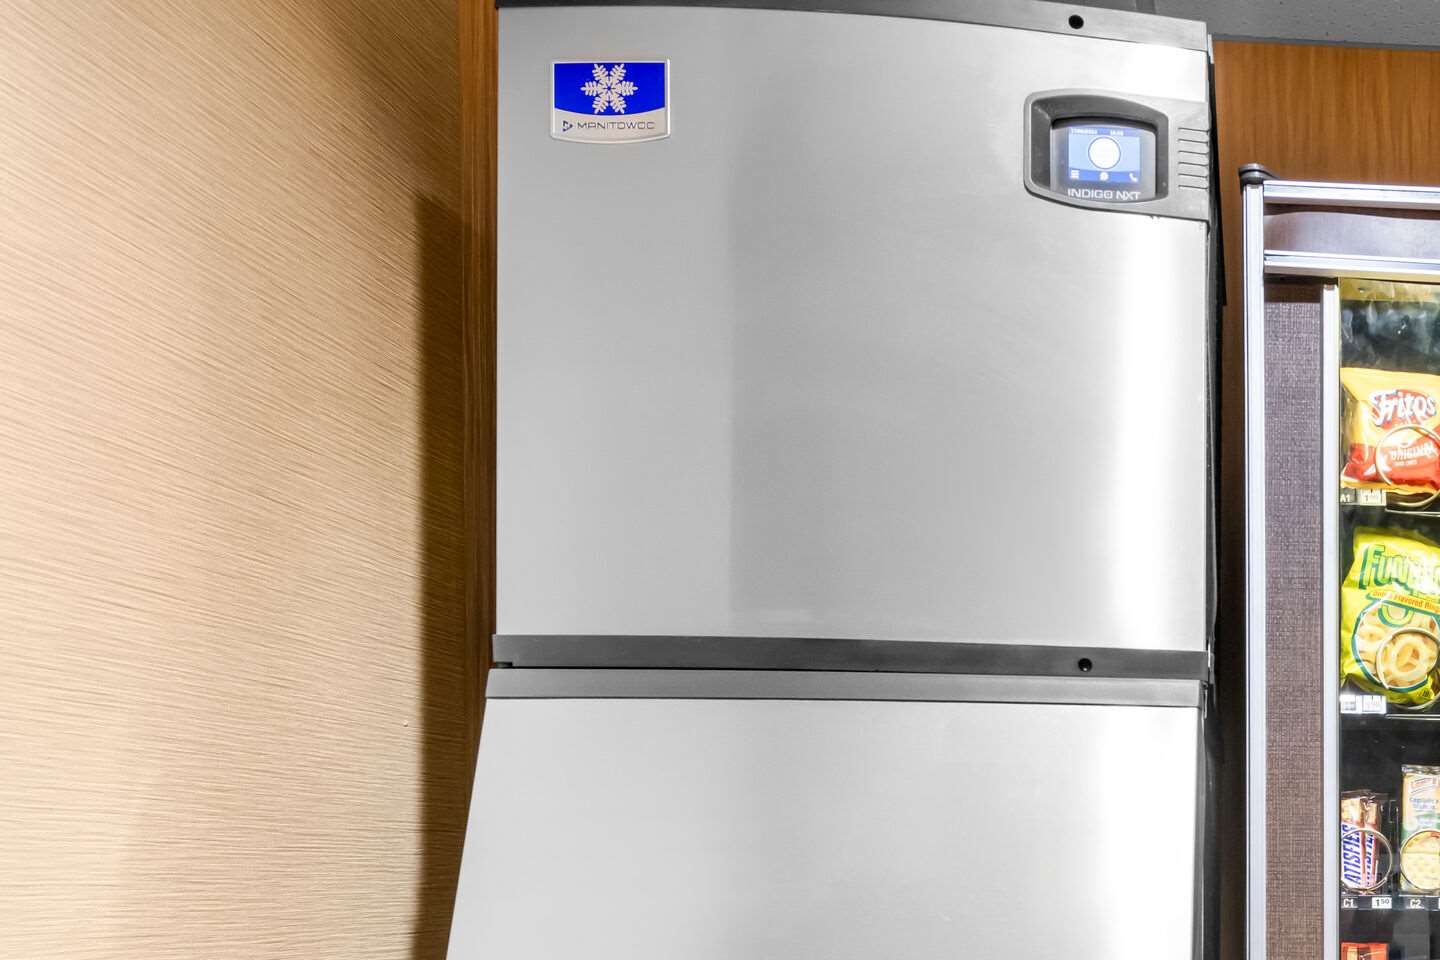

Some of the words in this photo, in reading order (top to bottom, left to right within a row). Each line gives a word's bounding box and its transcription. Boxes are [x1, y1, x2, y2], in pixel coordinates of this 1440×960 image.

[577, 121, 656, 130] MANITOWOC
[1067, 188, 1113, 200] INDIGO
[1116, 190, 1142, 201] NXT
[1369, 389, 1437, 426] Fritos
